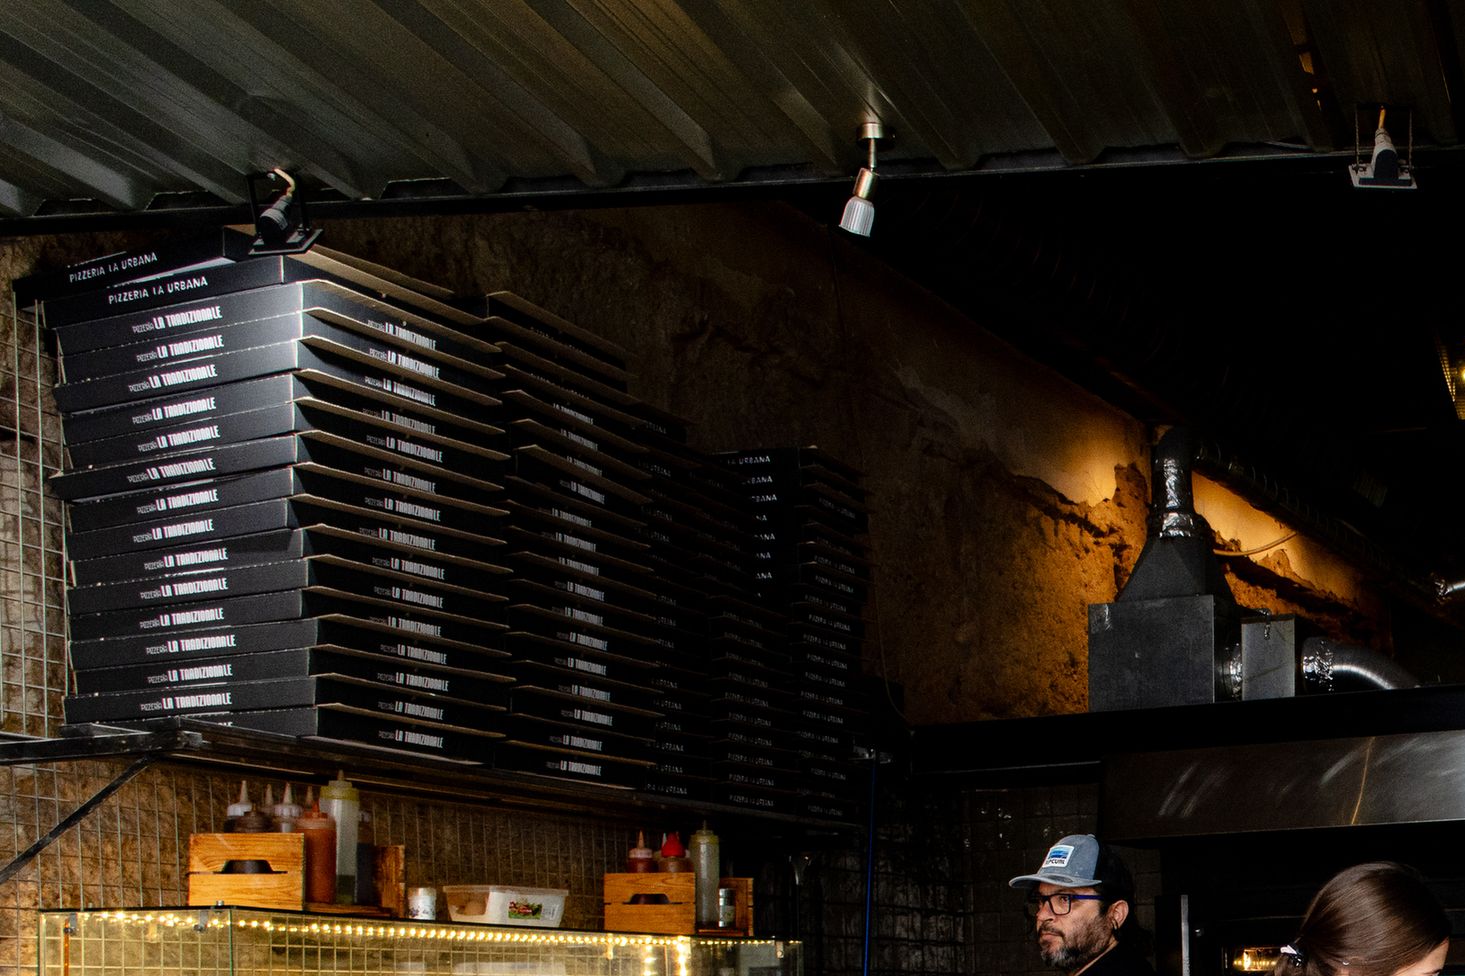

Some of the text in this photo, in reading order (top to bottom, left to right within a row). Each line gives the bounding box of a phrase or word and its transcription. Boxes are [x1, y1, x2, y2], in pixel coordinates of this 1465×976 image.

[70, 268, 105, 283] PIZZERIA
[121, 252, 158, 270] URBANA
[109, 289, 149, 304] PIZZERIA
[168, 276, 208, 293] URBANA
[153, 317, 164, 330] LA
[157, 346, 168, 358] LA
[149, 376, 160, 388] LA
[152, 409, 164, 420] LA
[157, 436, 168, 448] LA
[147, 468, 160, 480] LA
[156, 499, 167, 511] LA
[152, 528, 162, 540] LA
[164, 556, 175, 568] LA
[160, 586, 172, 597] LA
[160, 614, 170, 626] LA
[168, 641, 179, 653] LA
[168, 670, 178, 682] LA
[162, 698, 174, 709] LA
